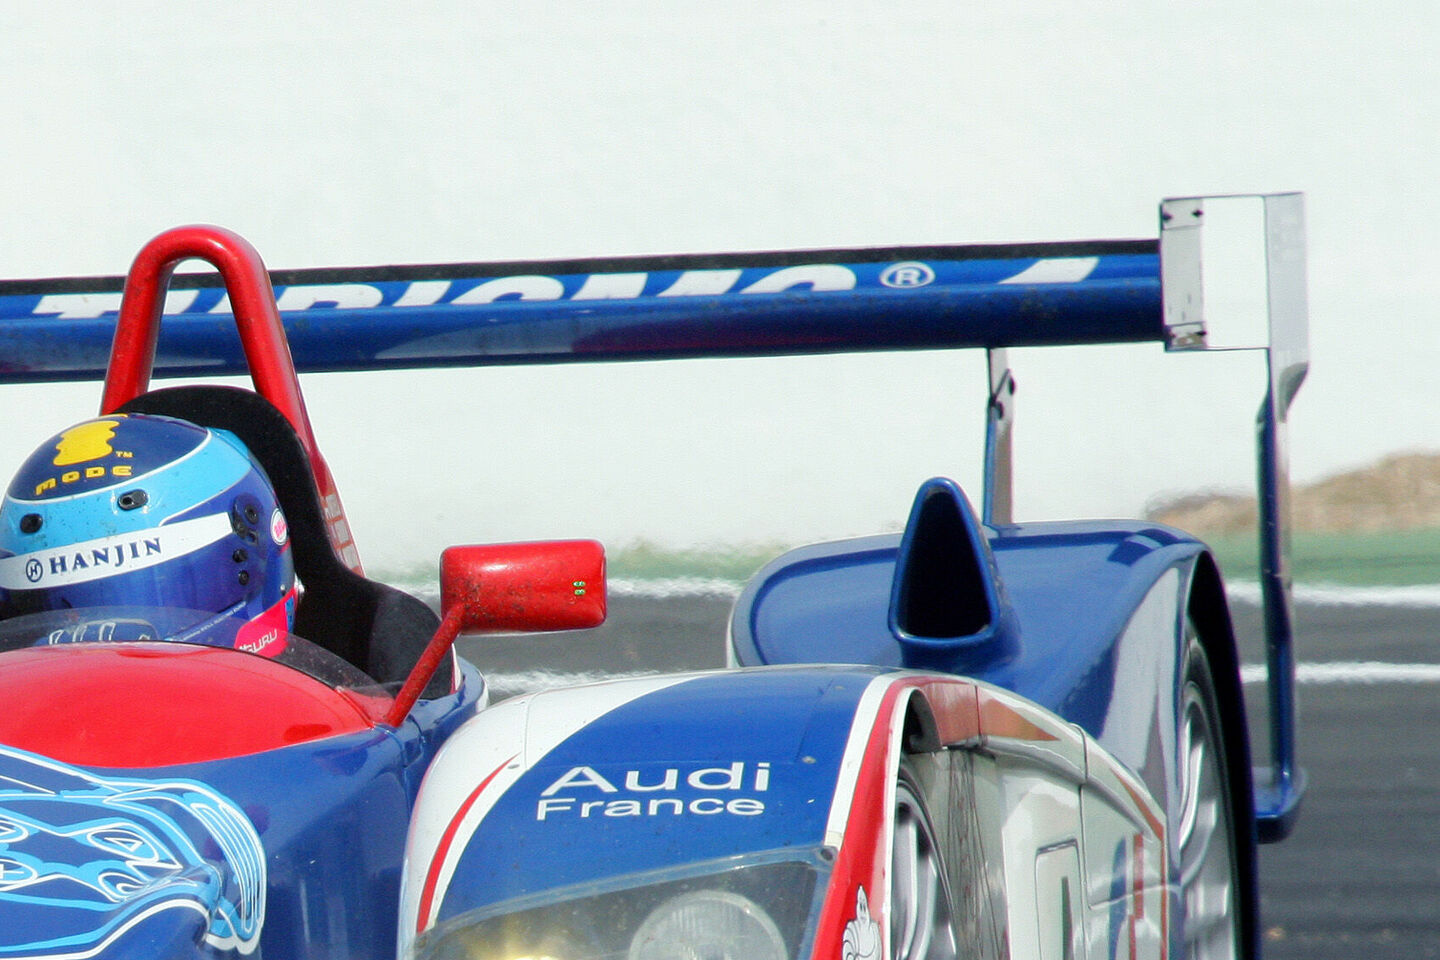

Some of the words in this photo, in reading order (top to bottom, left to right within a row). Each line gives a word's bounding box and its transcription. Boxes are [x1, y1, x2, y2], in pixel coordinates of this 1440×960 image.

[49, 537, 162, 574] HANJIN
[541, 762, 771, 796] Audi
[536, 797, 766, 821] France
